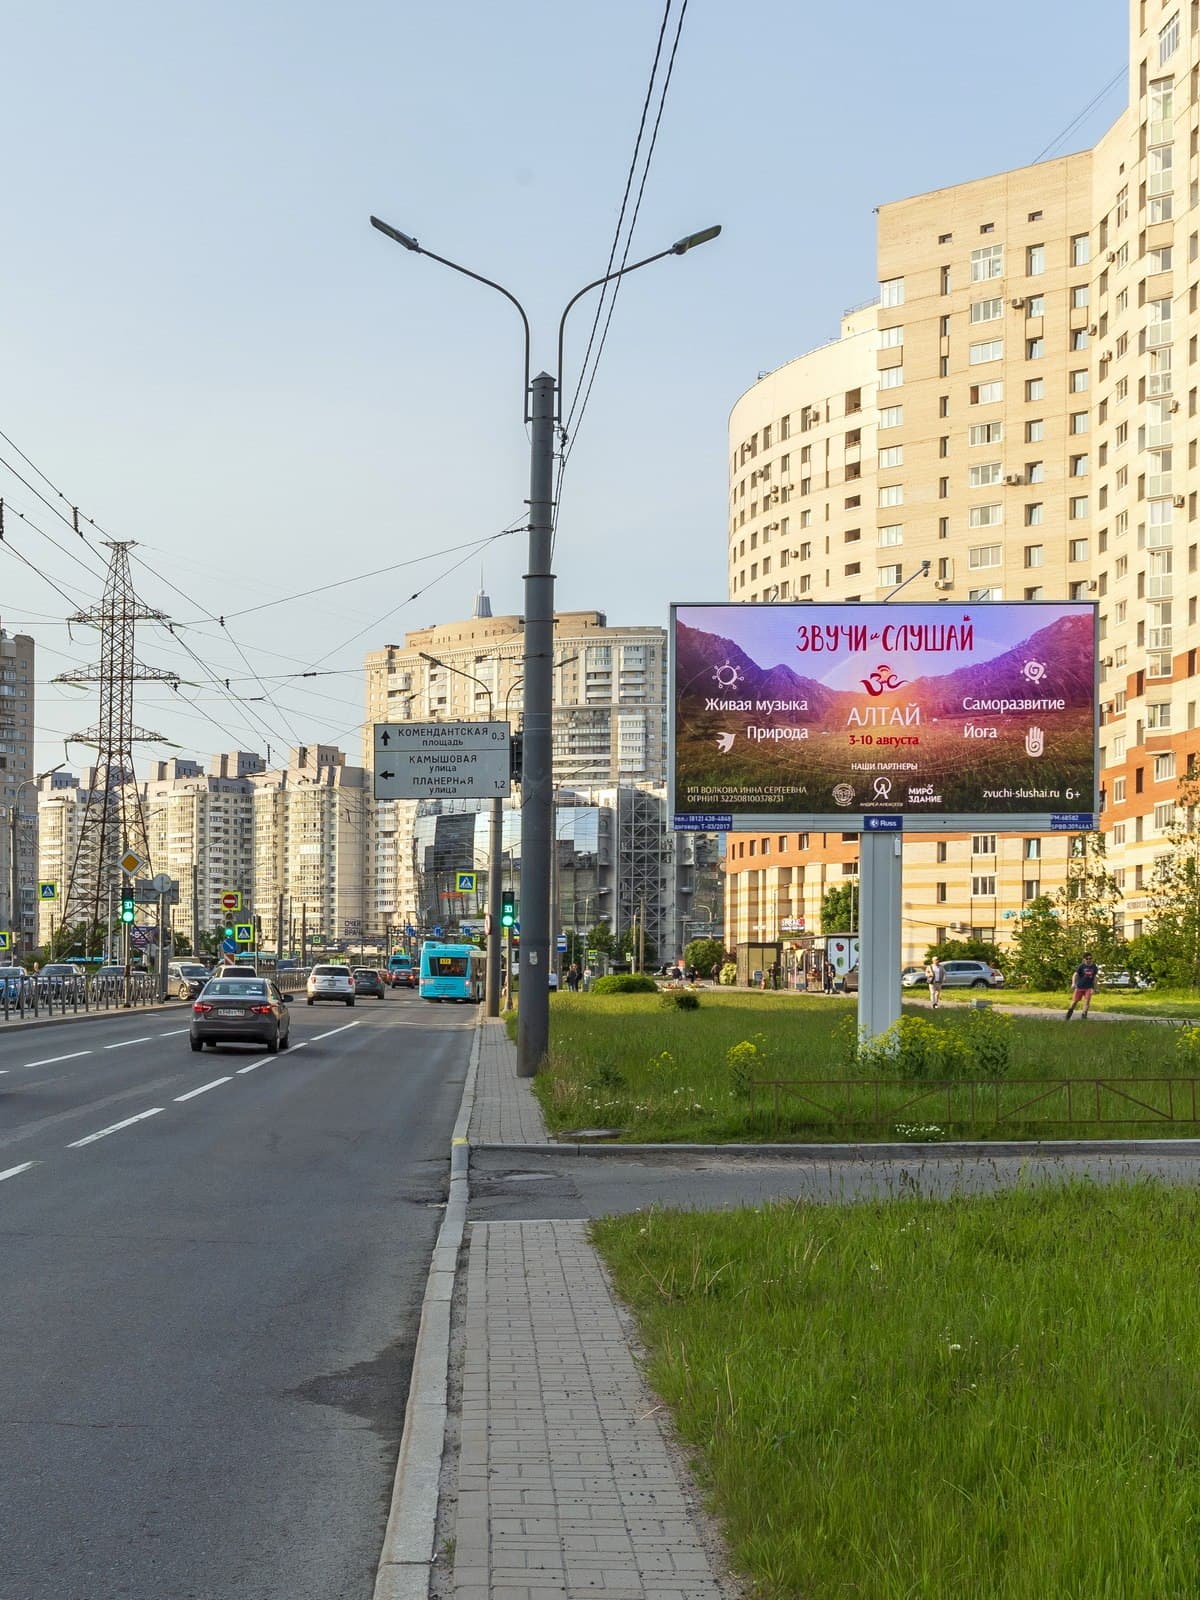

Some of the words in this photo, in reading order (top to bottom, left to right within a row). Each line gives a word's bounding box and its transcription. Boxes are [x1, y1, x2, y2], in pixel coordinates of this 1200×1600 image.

[796, 624, 867, 652] ЗВУЧИ
[882, 615, 973, 652] СЛУШАЙ
[704, 698, 752, 711] Живая
[756, 699, 809, 715] музыка
[962, 697, 1066, 714] Саморазвитие
[847, 703, 920, 726] АЛТАЙ
[398, 727, 488, 738] КОМЕНДАНТСКАЯ
[747, 726, 809, 742] Природа
[964, 722, 998, 738] Йога
[422, 738, 464, 747] площадь
[849, 735, 873, 745] 3-10
[876, 736, 920, 748] августа
[409, 755, 477, 764] КАМЫШОВАЯ
[429, 765, 457, 773] улица
[851, 762, 876, 771] НАШИ
[877, 762, 918, 771] ПАРТНЕРЫ
[412, 776, 474, 786] ПЛАНЕРНАЯ
[429, 787, 457, 795] улица
[687, 786, 699, 794] ИП
[701, 786, 738, 794] ВОЛКОВА
[740, 786, 762, 794] ИННА
[763, 785, 807, 794] СЕРГЕЕВНА
[982, 788, 1060, 798] zvuchi-slushai.ru
[1065, 788, 1081, 800] 6+
[908, 795, 943, 803] ЗДАНИЕ
[880, 819, 897, 827] Russ
